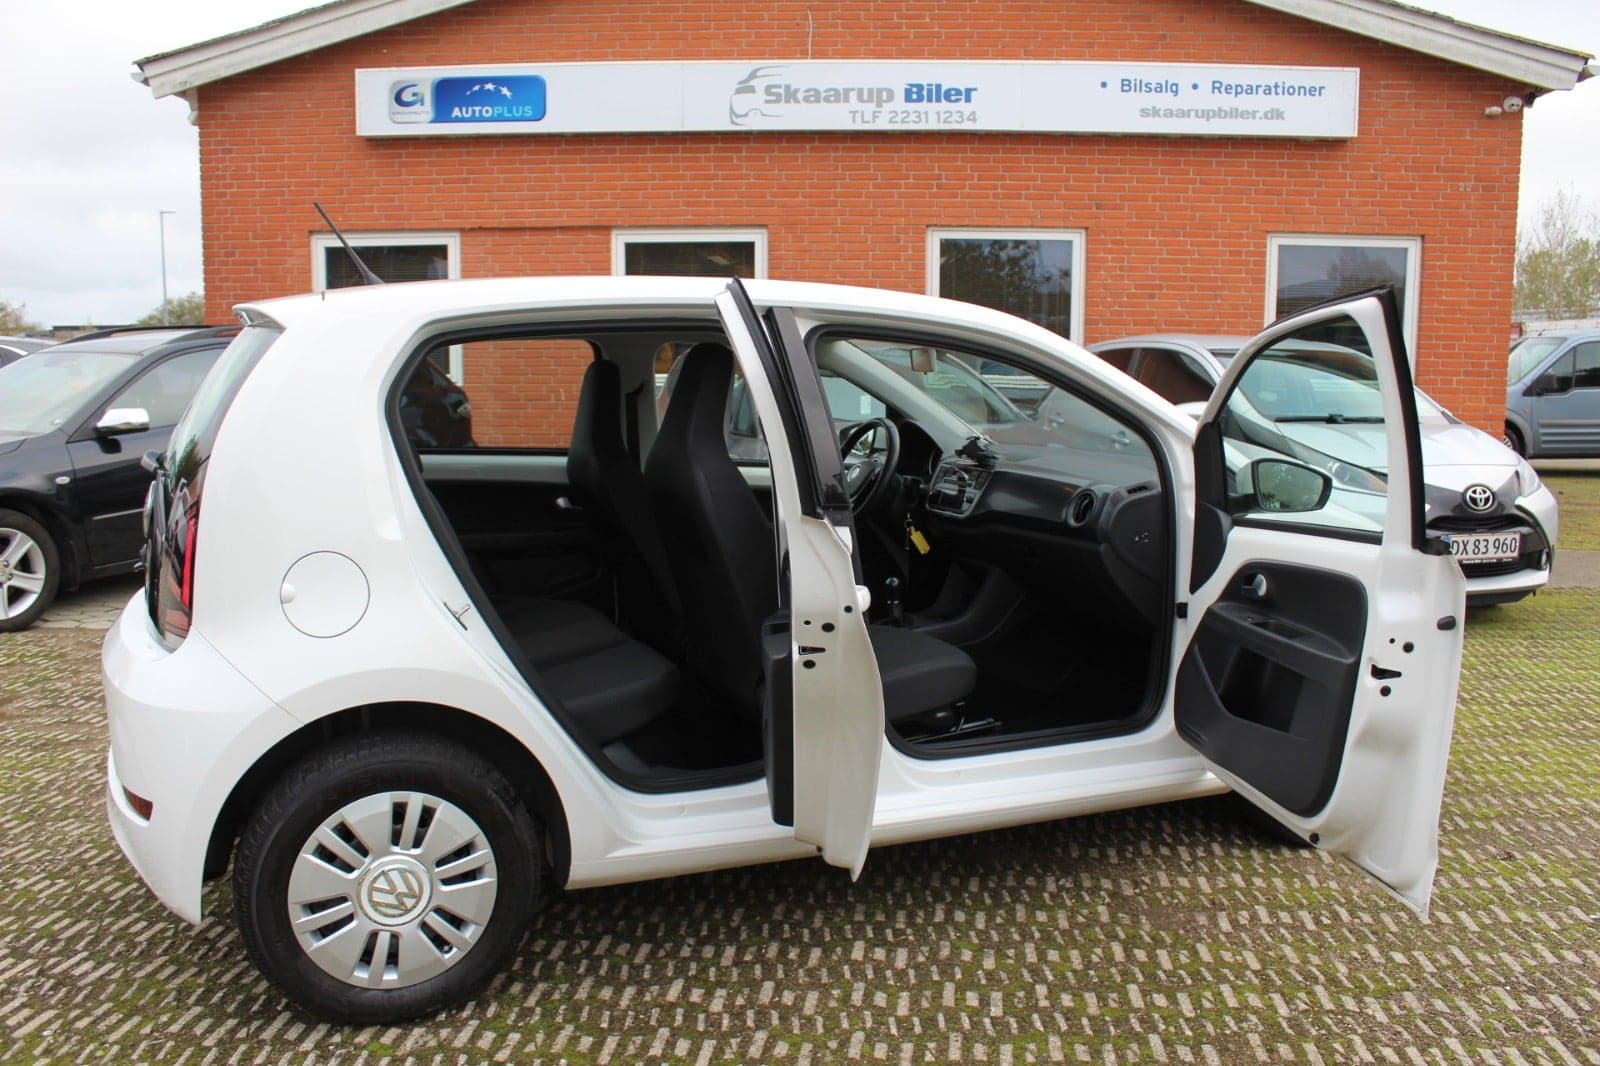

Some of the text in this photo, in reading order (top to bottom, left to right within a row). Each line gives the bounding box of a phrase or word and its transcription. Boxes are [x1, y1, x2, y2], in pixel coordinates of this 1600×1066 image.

[764, 83, 978, 107] Skaarup Biler
[1120, 79, 1179, 96] Bilsalg
[1211, 80, 1326, 97] Reparationer
[451, 106, 533, 118] AUTOPLUS
[849, 110, 978, 124] TLF 2231 1234
[1139, 105, 1286, 121] skaarupbiler.dk
[1451, 537, 1517, 556] DX 83 960
